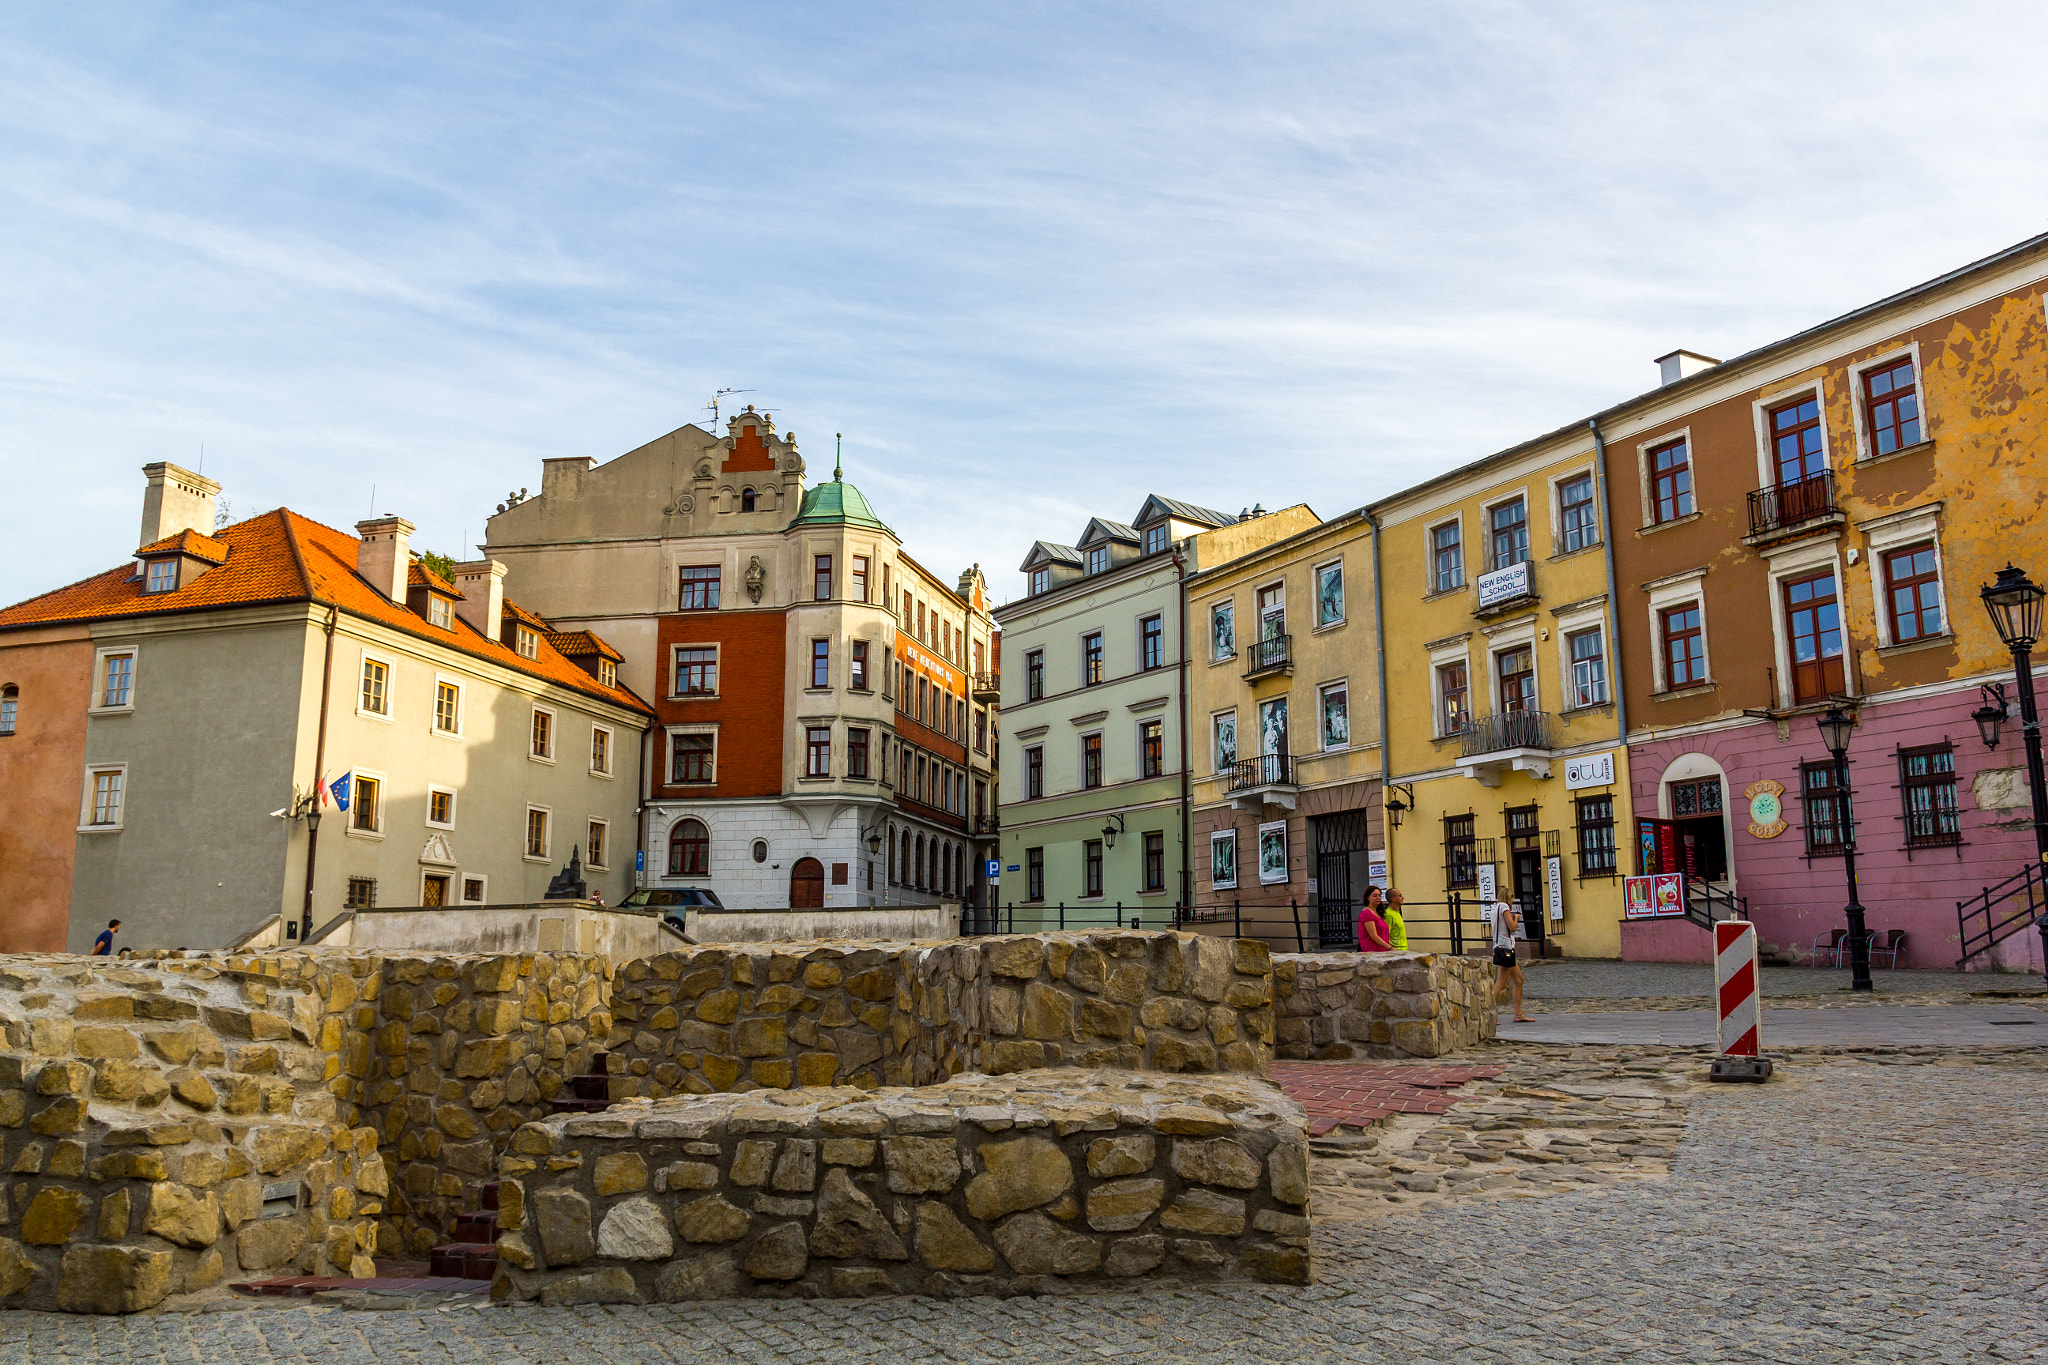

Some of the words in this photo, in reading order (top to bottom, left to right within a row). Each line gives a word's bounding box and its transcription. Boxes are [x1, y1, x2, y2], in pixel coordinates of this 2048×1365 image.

[1480, 579, 1495, 590] NEW
[1488, 582, 1516, 596] SCHOOL
[1747, 782, 1780, 797] LODY
[1750, 820, 1784, 836] GOFRY
[989, 861, 999, 875] P
[1549, 861, 1560, 907] galeria
[1480, 876, 1494, 920] galeria
